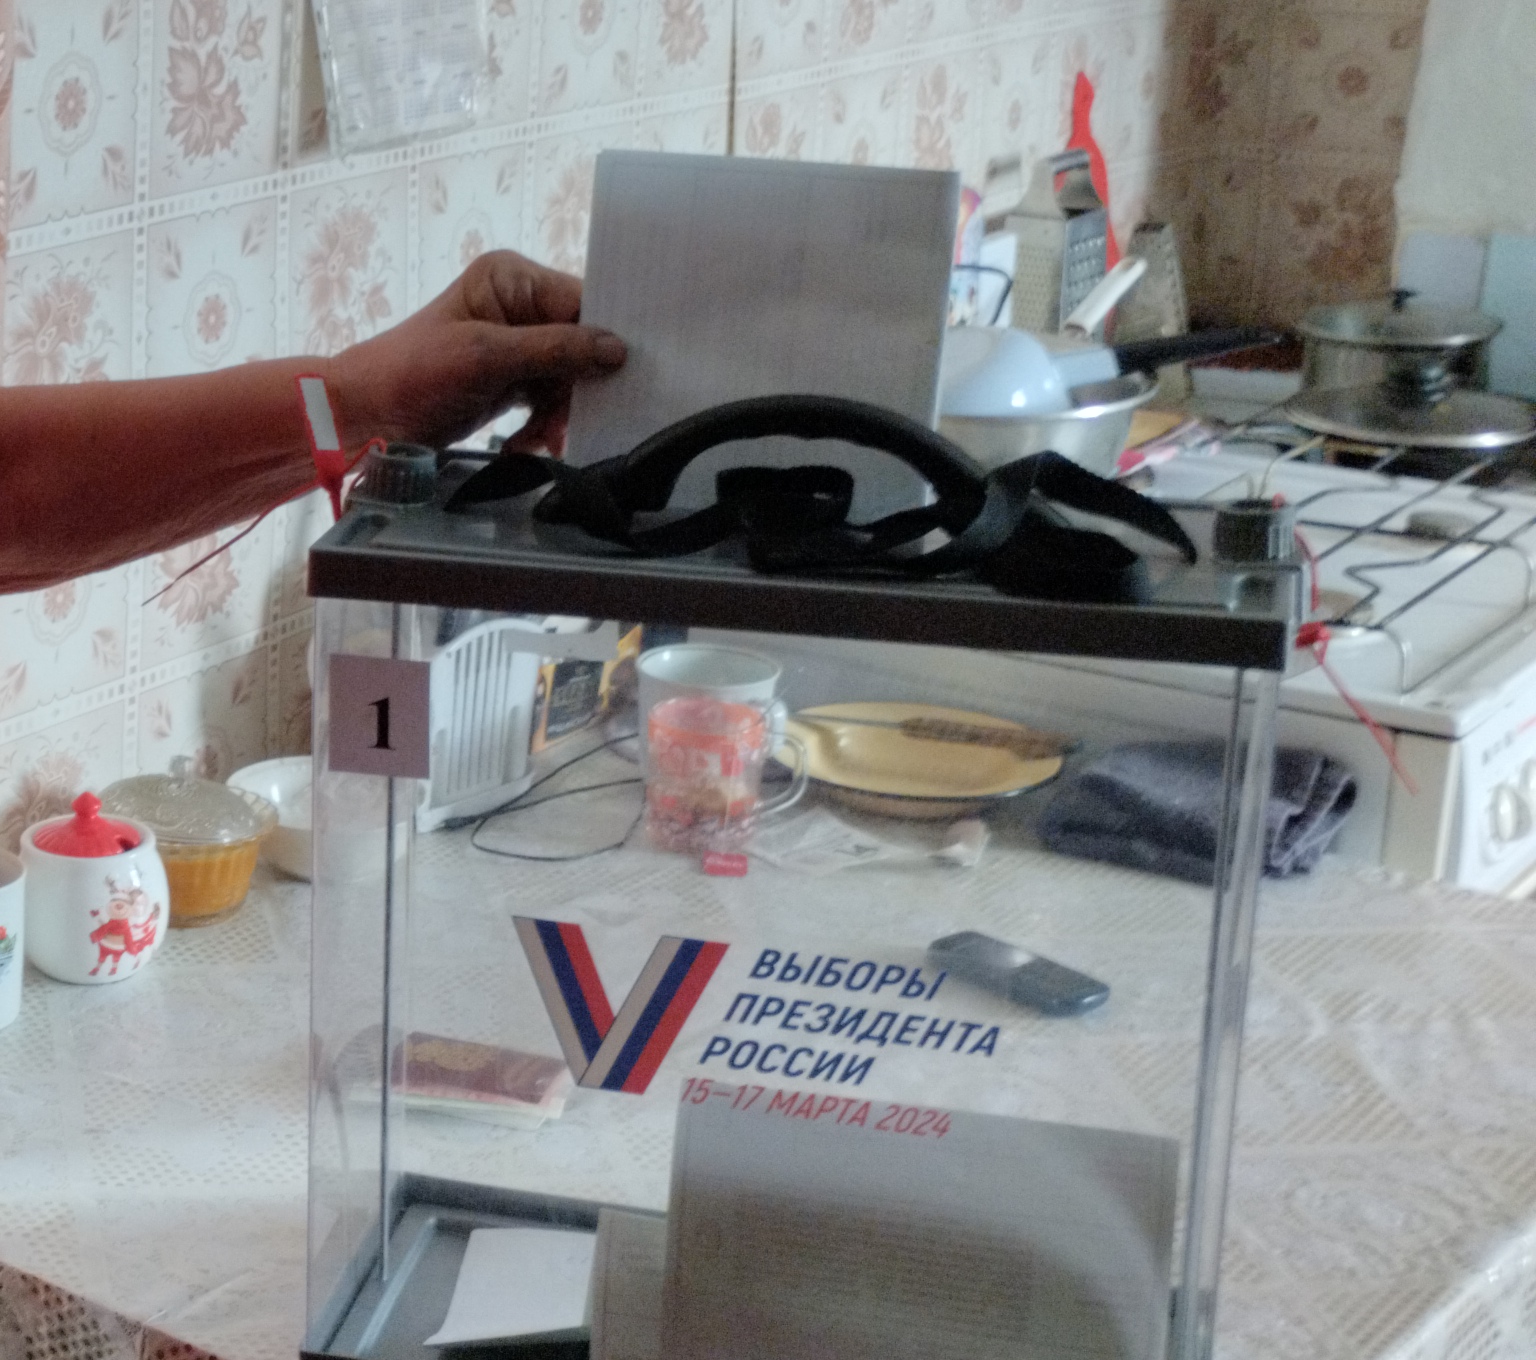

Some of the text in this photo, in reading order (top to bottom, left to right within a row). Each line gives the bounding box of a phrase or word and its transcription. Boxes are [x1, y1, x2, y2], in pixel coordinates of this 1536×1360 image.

[367, 696, 396, 751] 1
[749, 948, 948, 1002] ВЫБОРЫ
[723, 992, 1001, 1058] ПРЕЗИДЕНТА
[698, 1036, 877, 1086] РОССИИ
[766, 1089, 872, 1128] МАРТА
[874, 1103, 953, 1139] 2024
